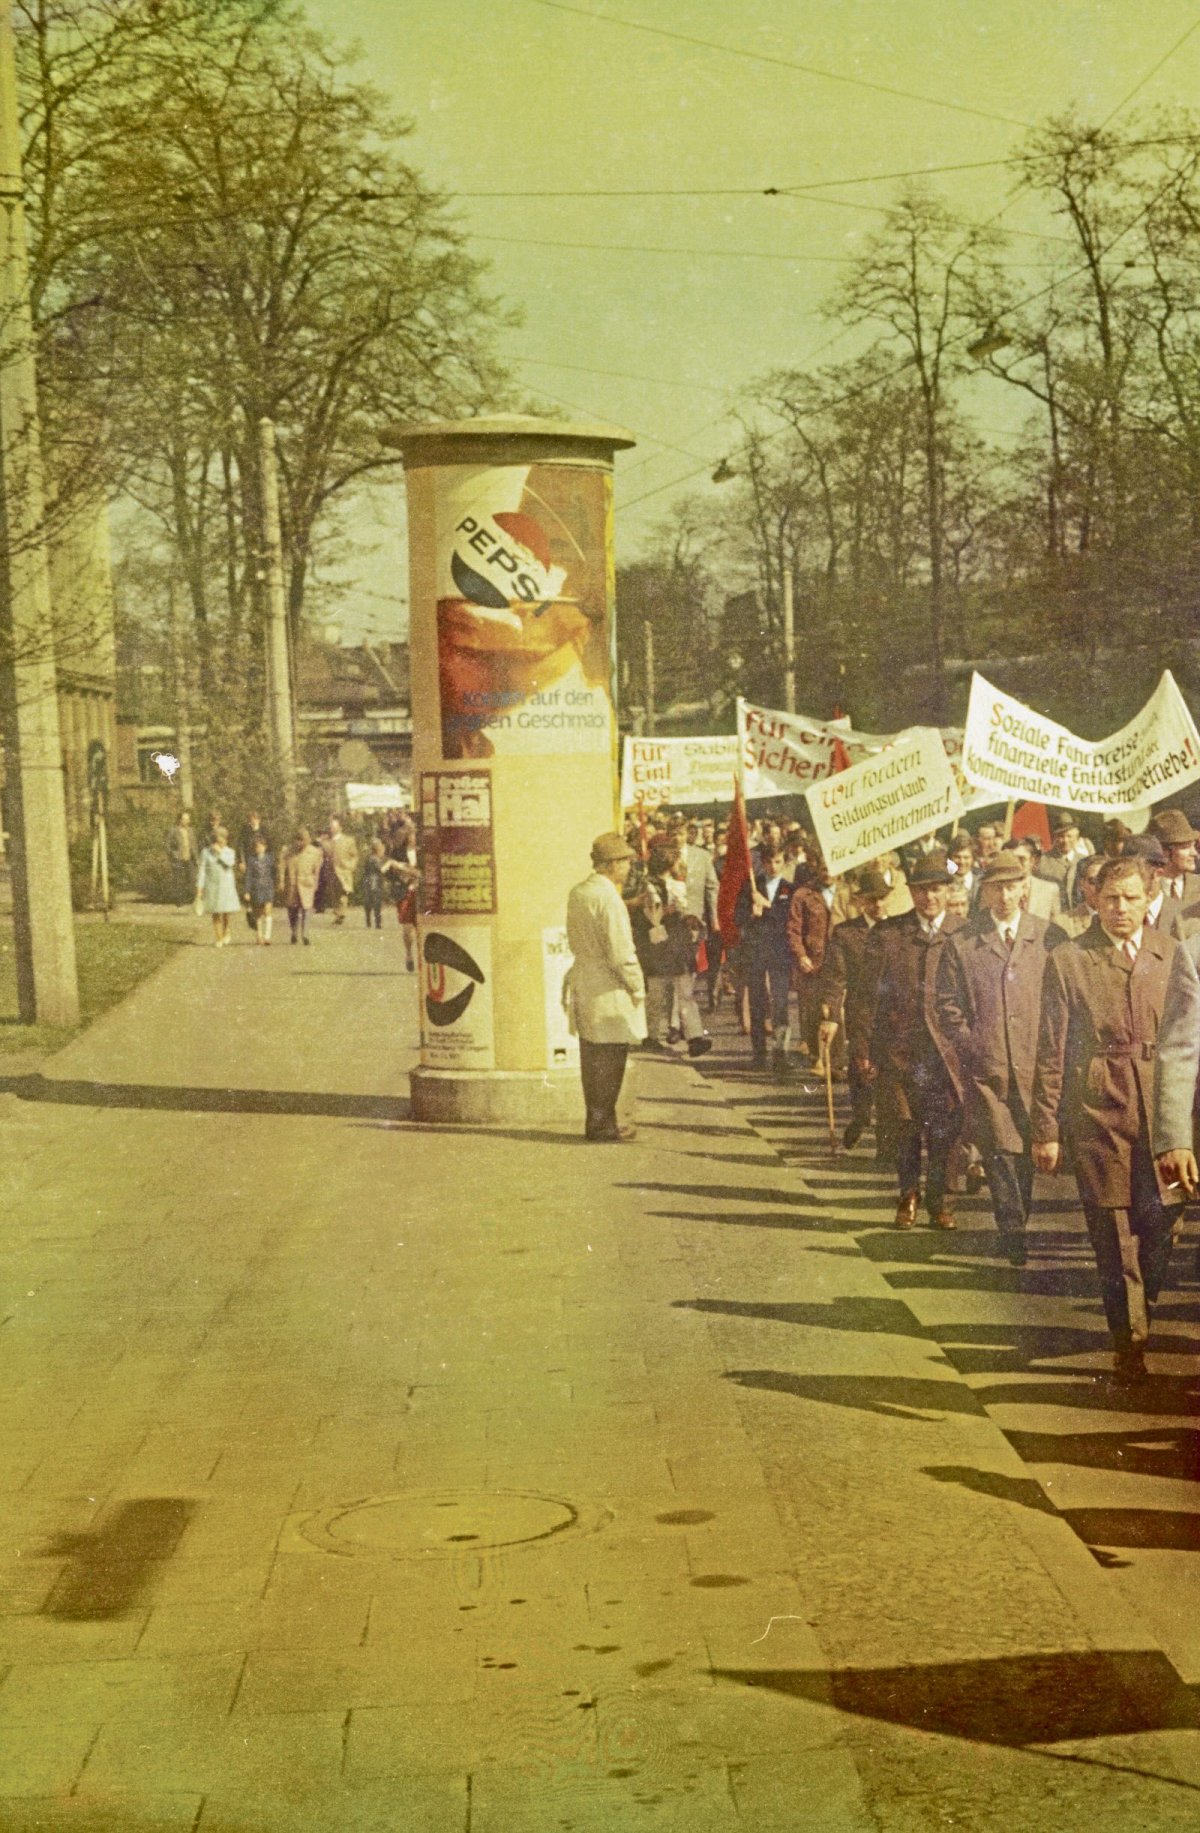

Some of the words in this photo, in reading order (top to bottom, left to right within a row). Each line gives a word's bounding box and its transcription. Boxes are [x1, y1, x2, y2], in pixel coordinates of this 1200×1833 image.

[455, 516, 552, 618] PEPSI
[531, 688, 562, 706] auf
[564, 689, 594, 706] den
[746, 709, 790, 741] Für
[990, 703, 1050, 751] Soziale
[861, 750, 922, 793] fordern
[966, 746, 1062, 798] kommunalen
[988, 731, 1068, 780] finanzielle
[830, 775, 928, 833] Bildungsurlaub
[848, 785, 951, 854] Arbeitnehmer!
